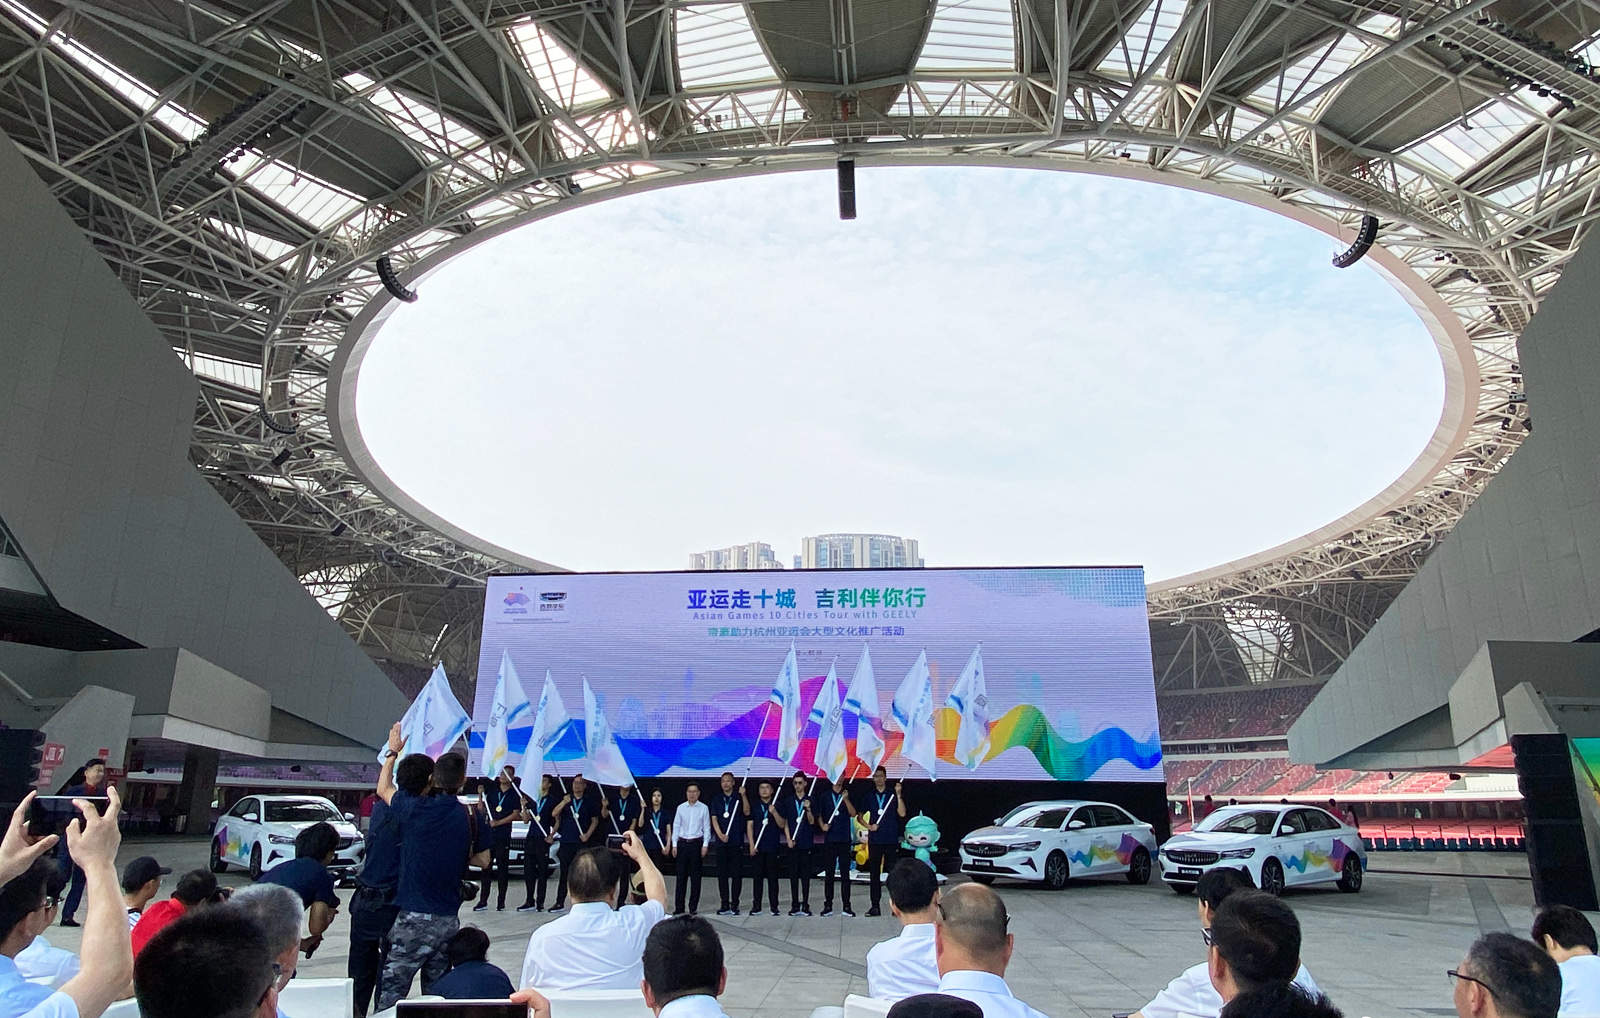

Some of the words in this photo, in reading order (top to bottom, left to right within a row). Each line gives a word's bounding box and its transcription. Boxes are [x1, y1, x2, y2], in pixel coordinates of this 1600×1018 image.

[687, 589, 796, 609] 亚运走十城
[815, 588, 926, 608] 吉利伴你行
[693, 611, 723, 620] Asian
[728, 611, 764, 620] Games
[769, 611, 782, 620] 10
[786, 610, 818, 619] Cities
[824, 610, 848, 619] Tour
[853, 610, 878, 619] with
[883, 610, 917, 619] GEELY
